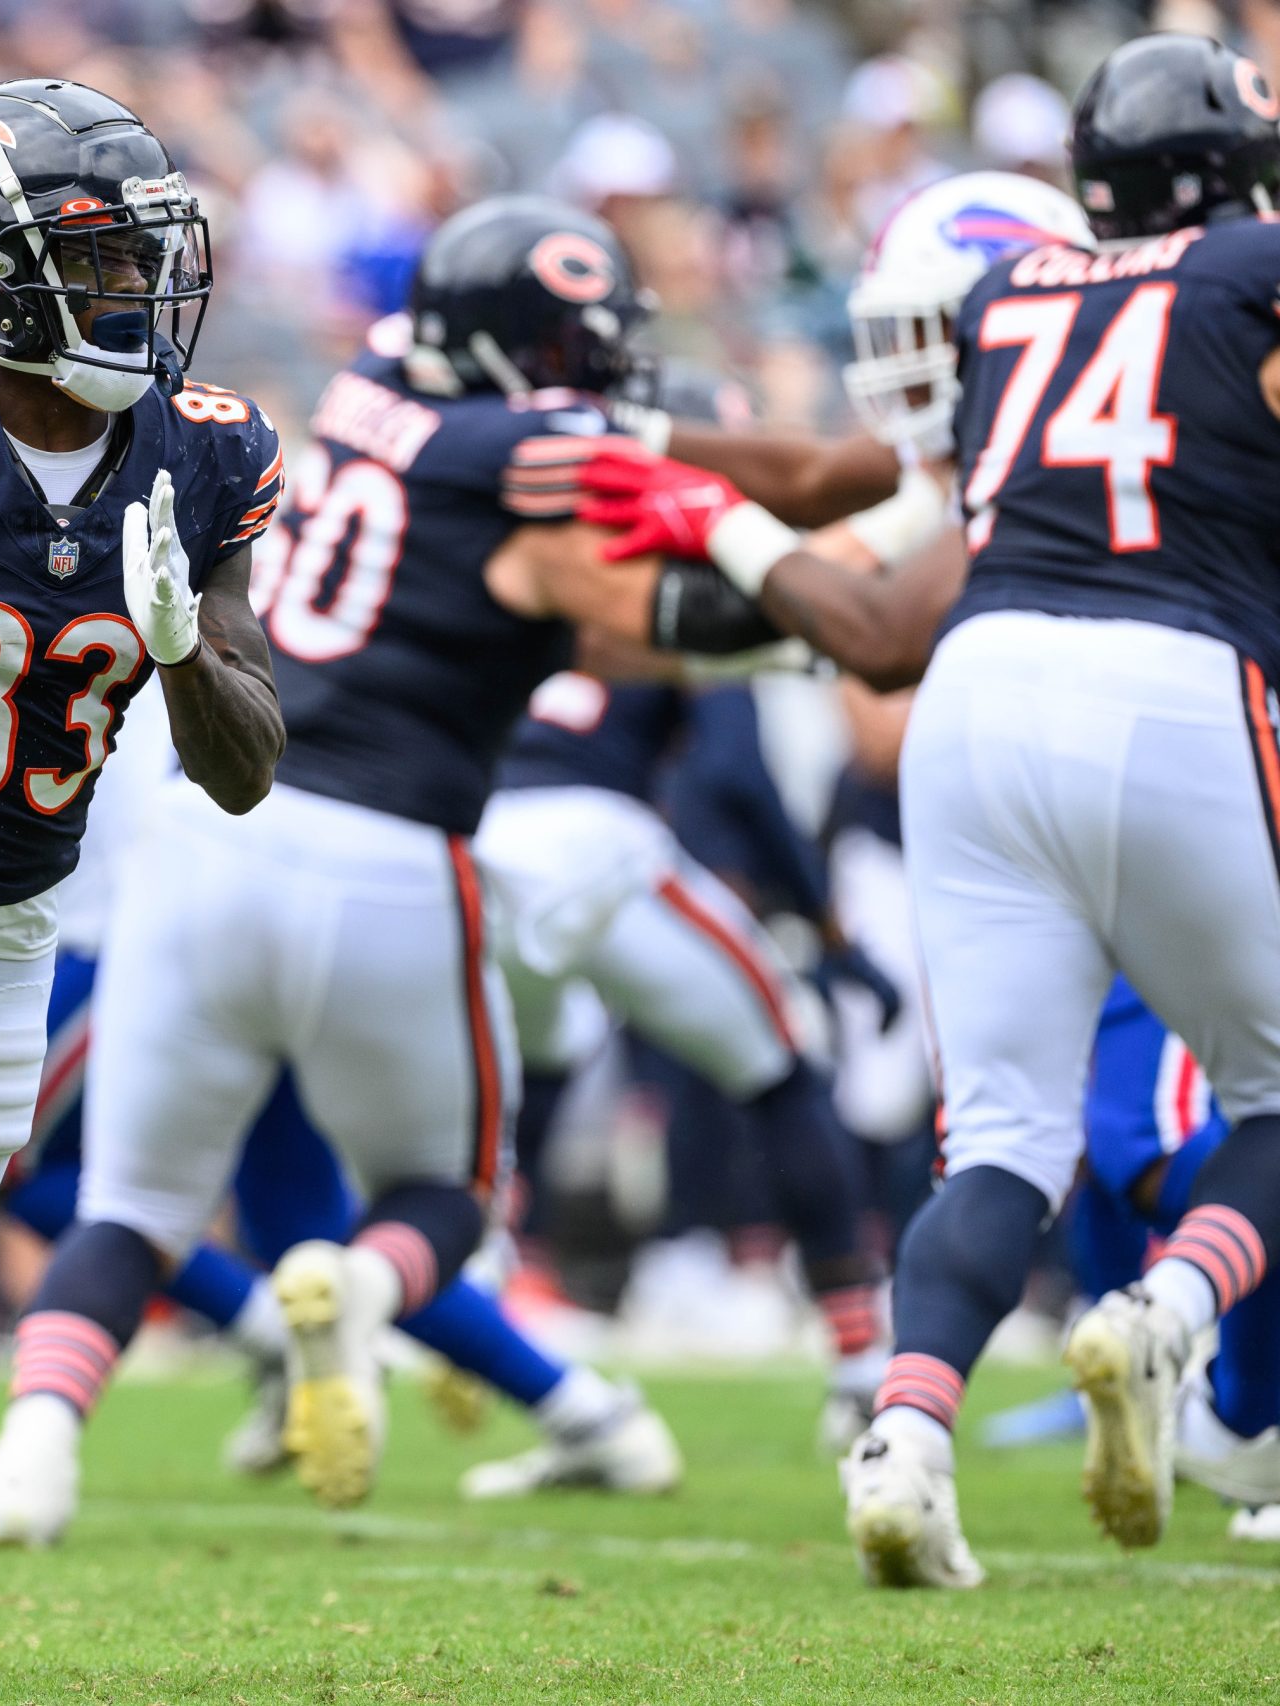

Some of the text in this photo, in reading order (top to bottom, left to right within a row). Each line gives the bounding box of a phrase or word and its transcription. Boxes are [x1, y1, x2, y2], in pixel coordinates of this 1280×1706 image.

[529, 231, 615, 304] C
[965, 281, 1178, 555] 74
[54, 556, 74, 572] NFL
